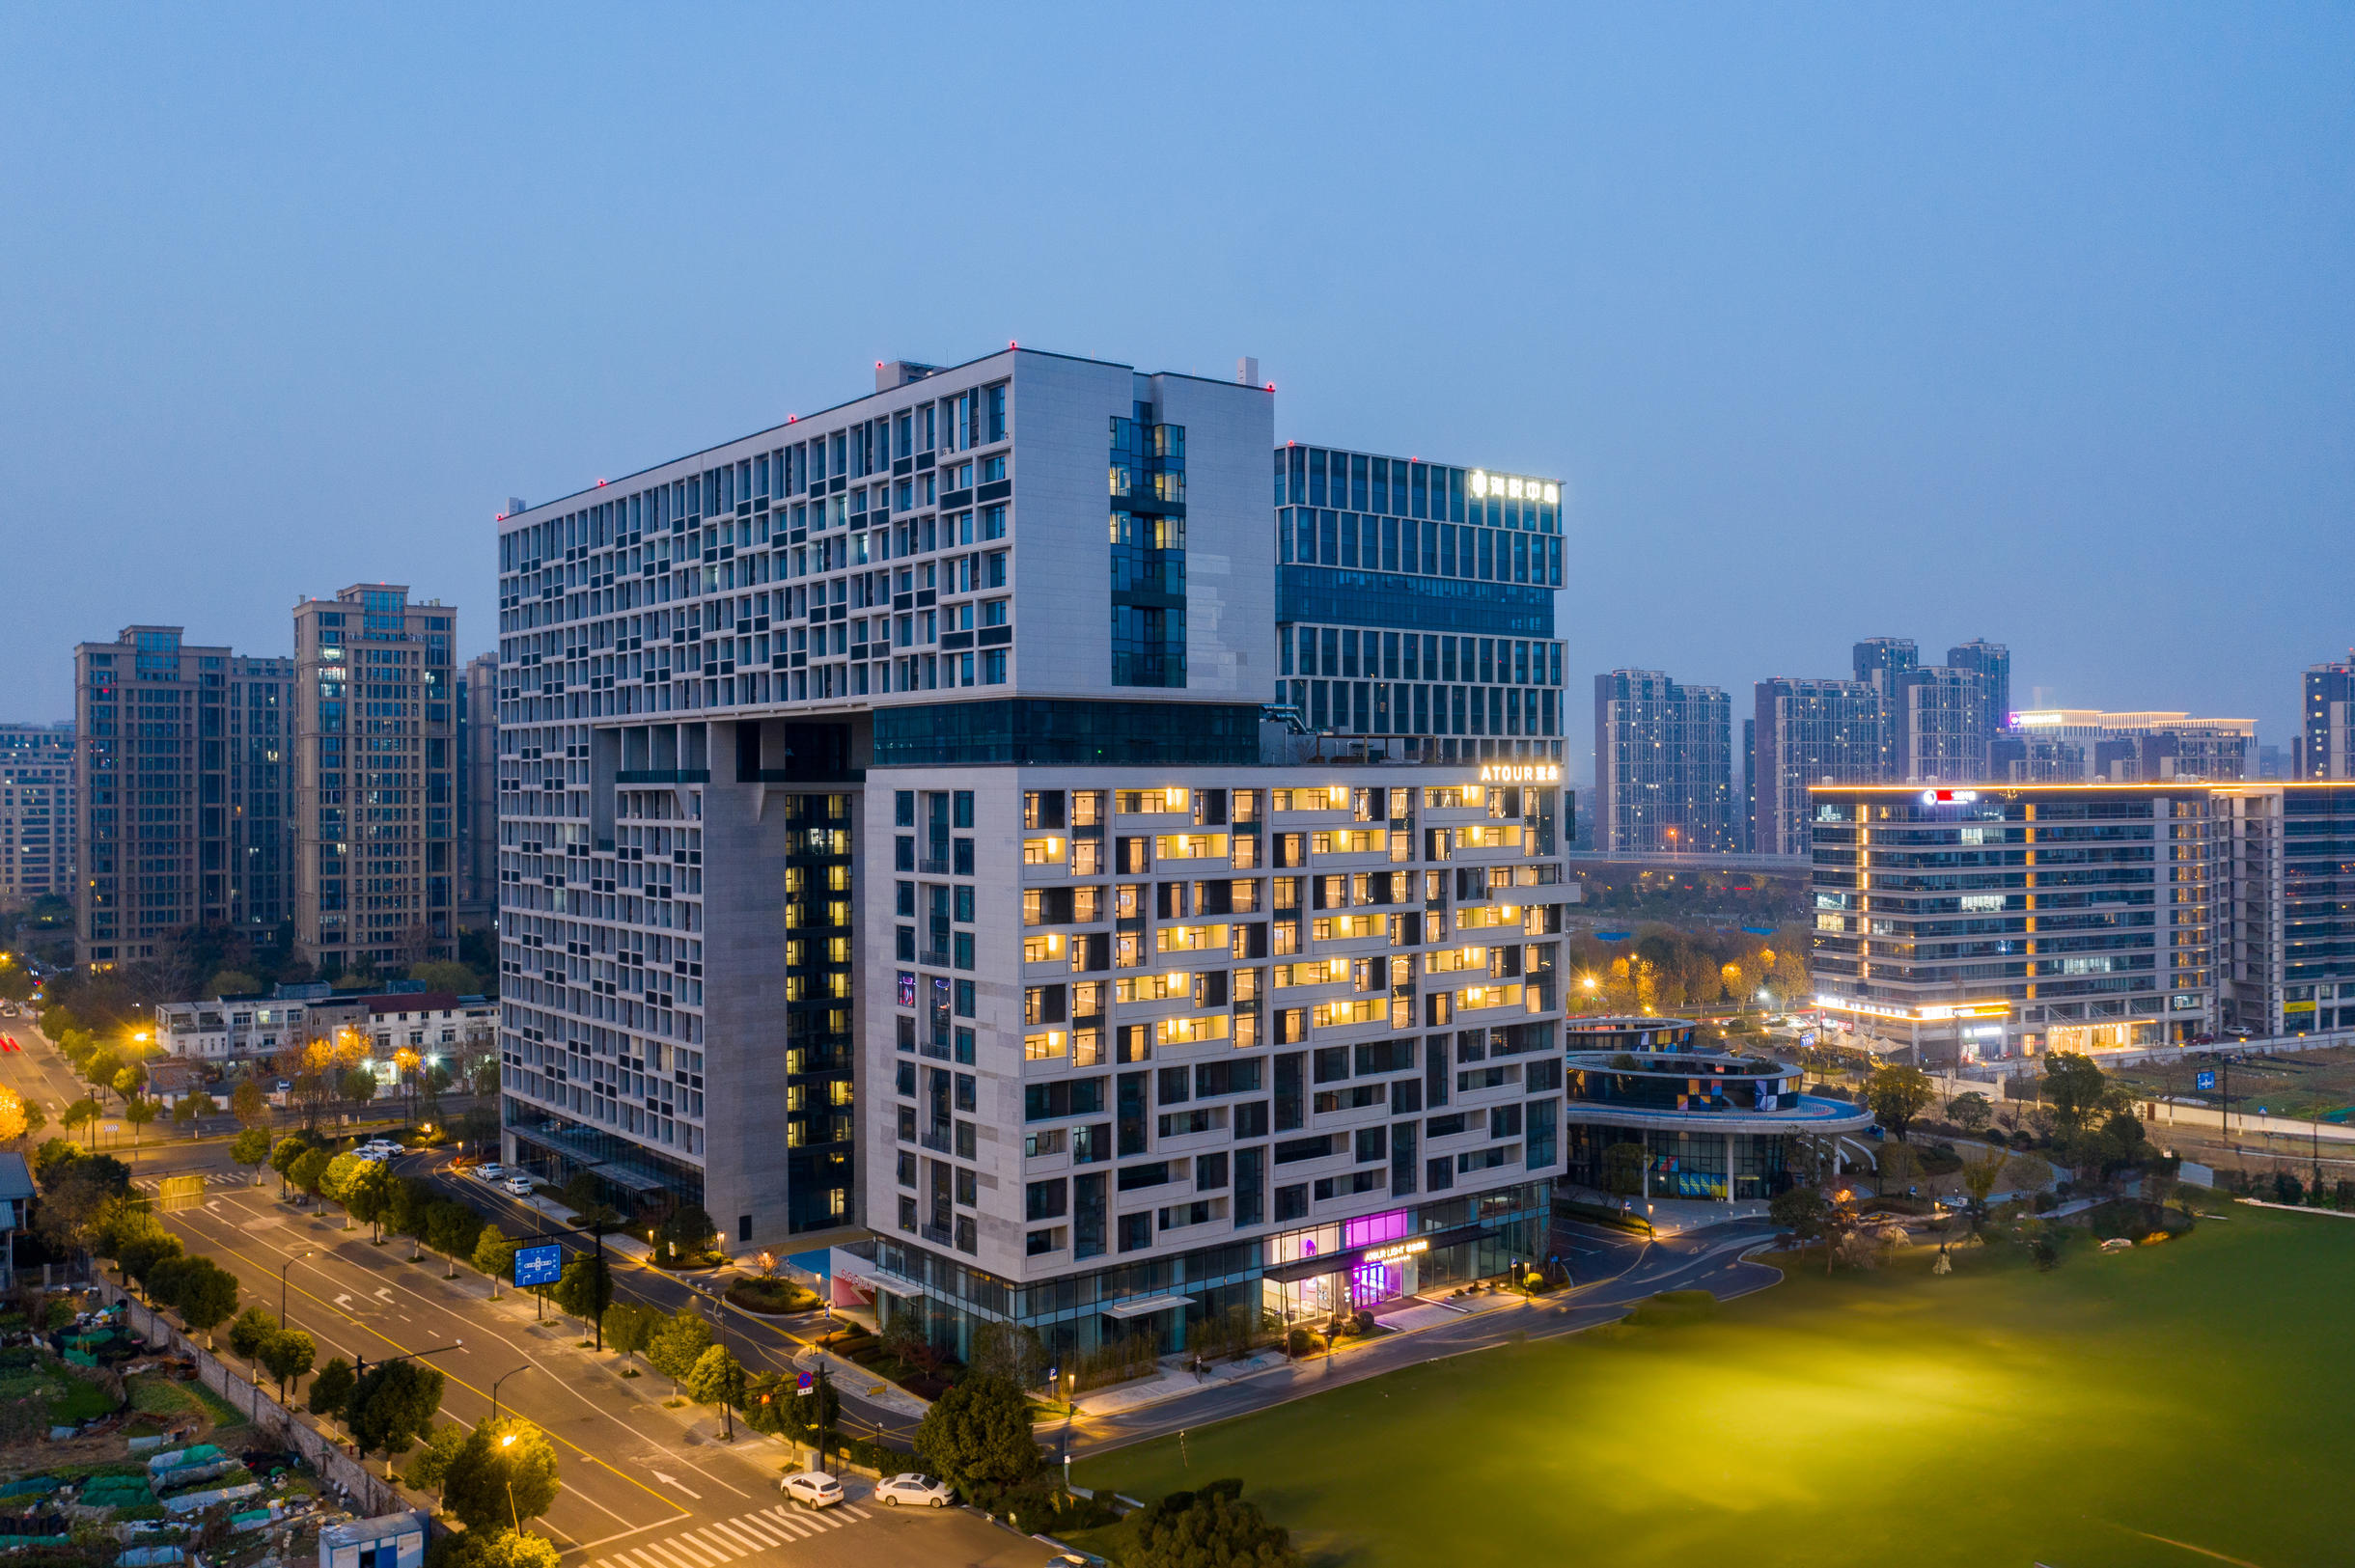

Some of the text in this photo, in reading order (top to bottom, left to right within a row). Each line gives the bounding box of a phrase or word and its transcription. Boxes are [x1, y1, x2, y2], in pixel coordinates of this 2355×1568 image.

[1481, 765, 1558, 781] ATOUR 亚朵
[1387, 1245, 1404, 1257] LIGHT
